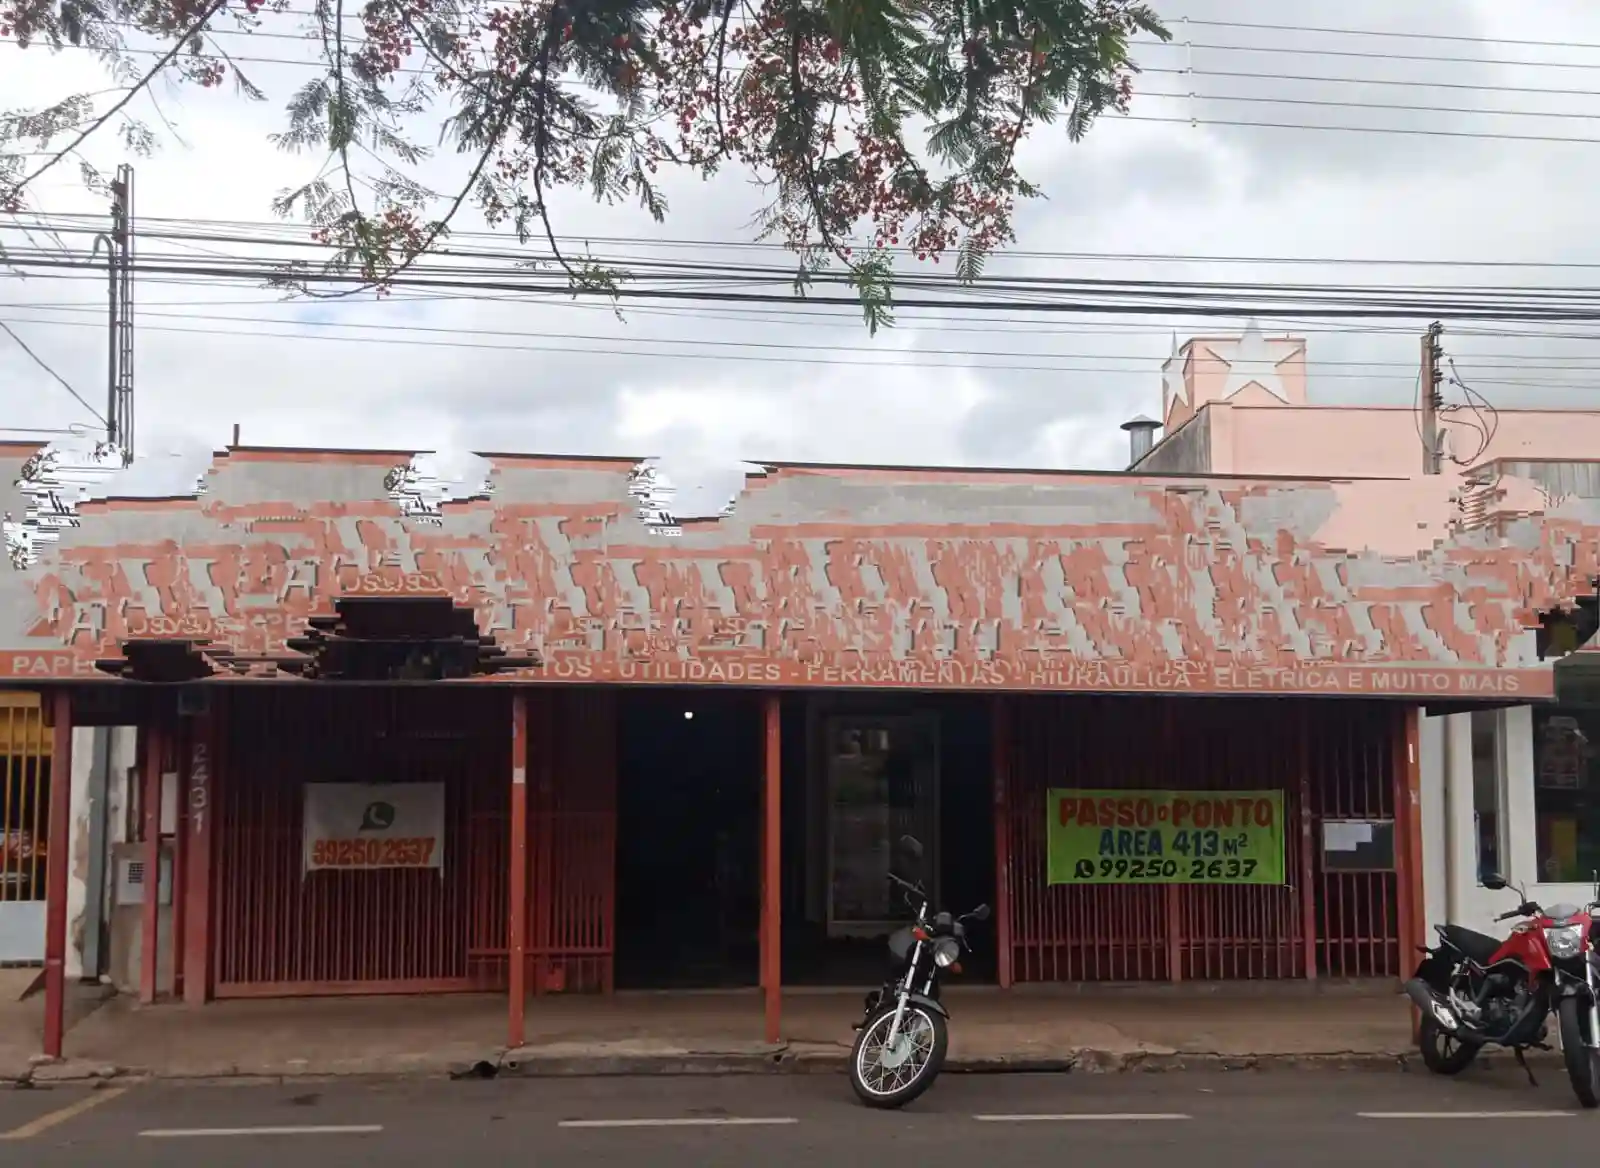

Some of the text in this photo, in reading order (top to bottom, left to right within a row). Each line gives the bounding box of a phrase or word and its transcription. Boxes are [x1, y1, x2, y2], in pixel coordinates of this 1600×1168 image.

[620, 661, 781, 681] UTILIDADES
[1348, 671, 1362, 689] E
[1371, 672, 1450, 690] MUITO
[1459, 673, 1520, 692] MAIS
[191, 743, 208, 835] 2431
[1059, 797, 1154, 828] PASSO
[1171, 797, 1274, 829] PONTO
[1171, 829, 1219, 857] 413
